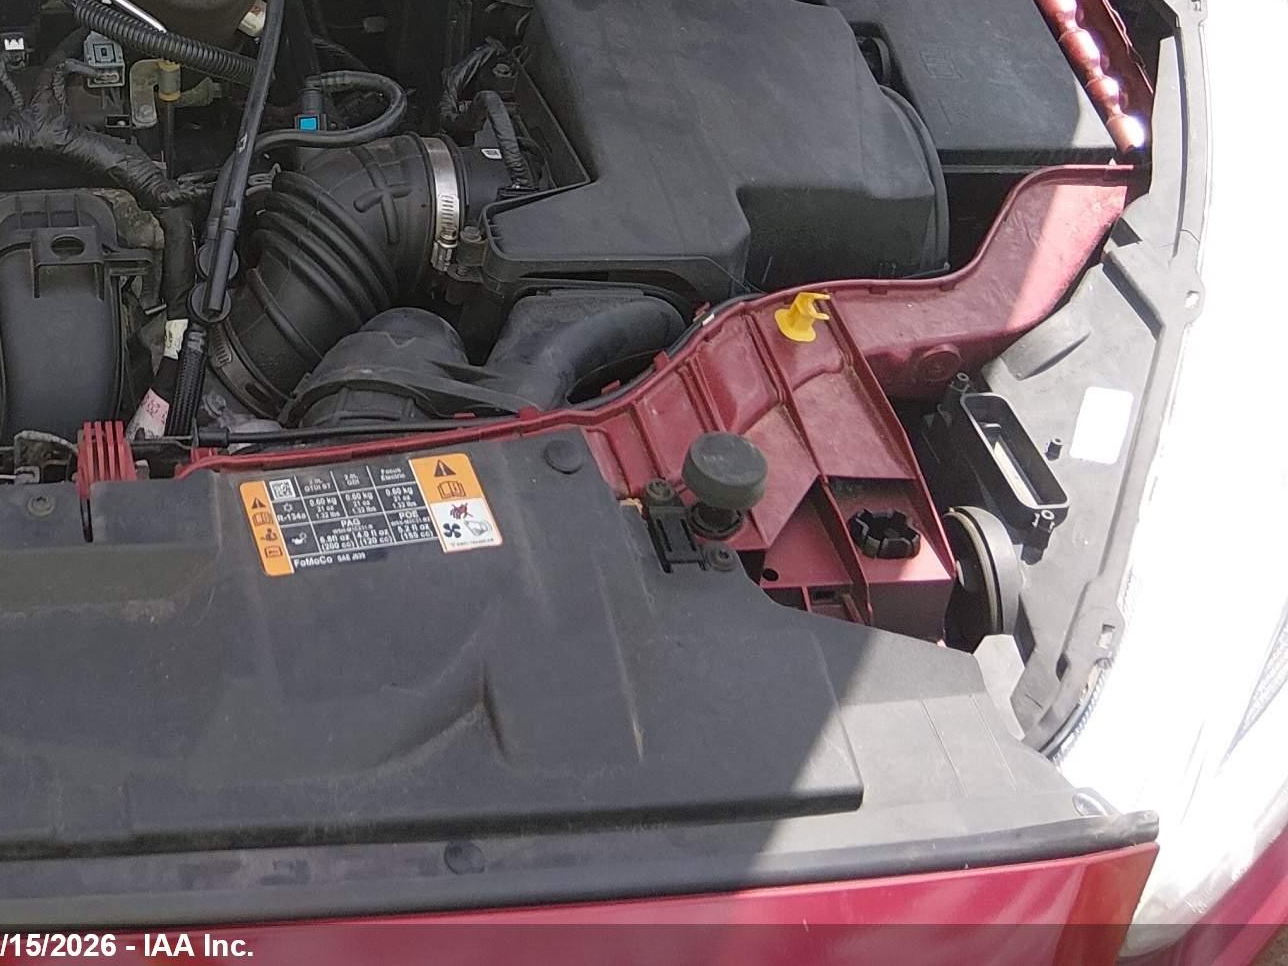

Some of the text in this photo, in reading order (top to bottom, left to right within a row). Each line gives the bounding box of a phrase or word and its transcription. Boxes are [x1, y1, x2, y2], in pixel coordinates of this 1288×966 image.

[362, 491, 373, 501] kg
[385, 486, 414, 497] 0.60 kg
[326, 496, 337, 506] kg
[398, 510, 419, 520] POE
[340, 518, 361, 528] PAG
[293, 555, 333, 568] FoMoCo
